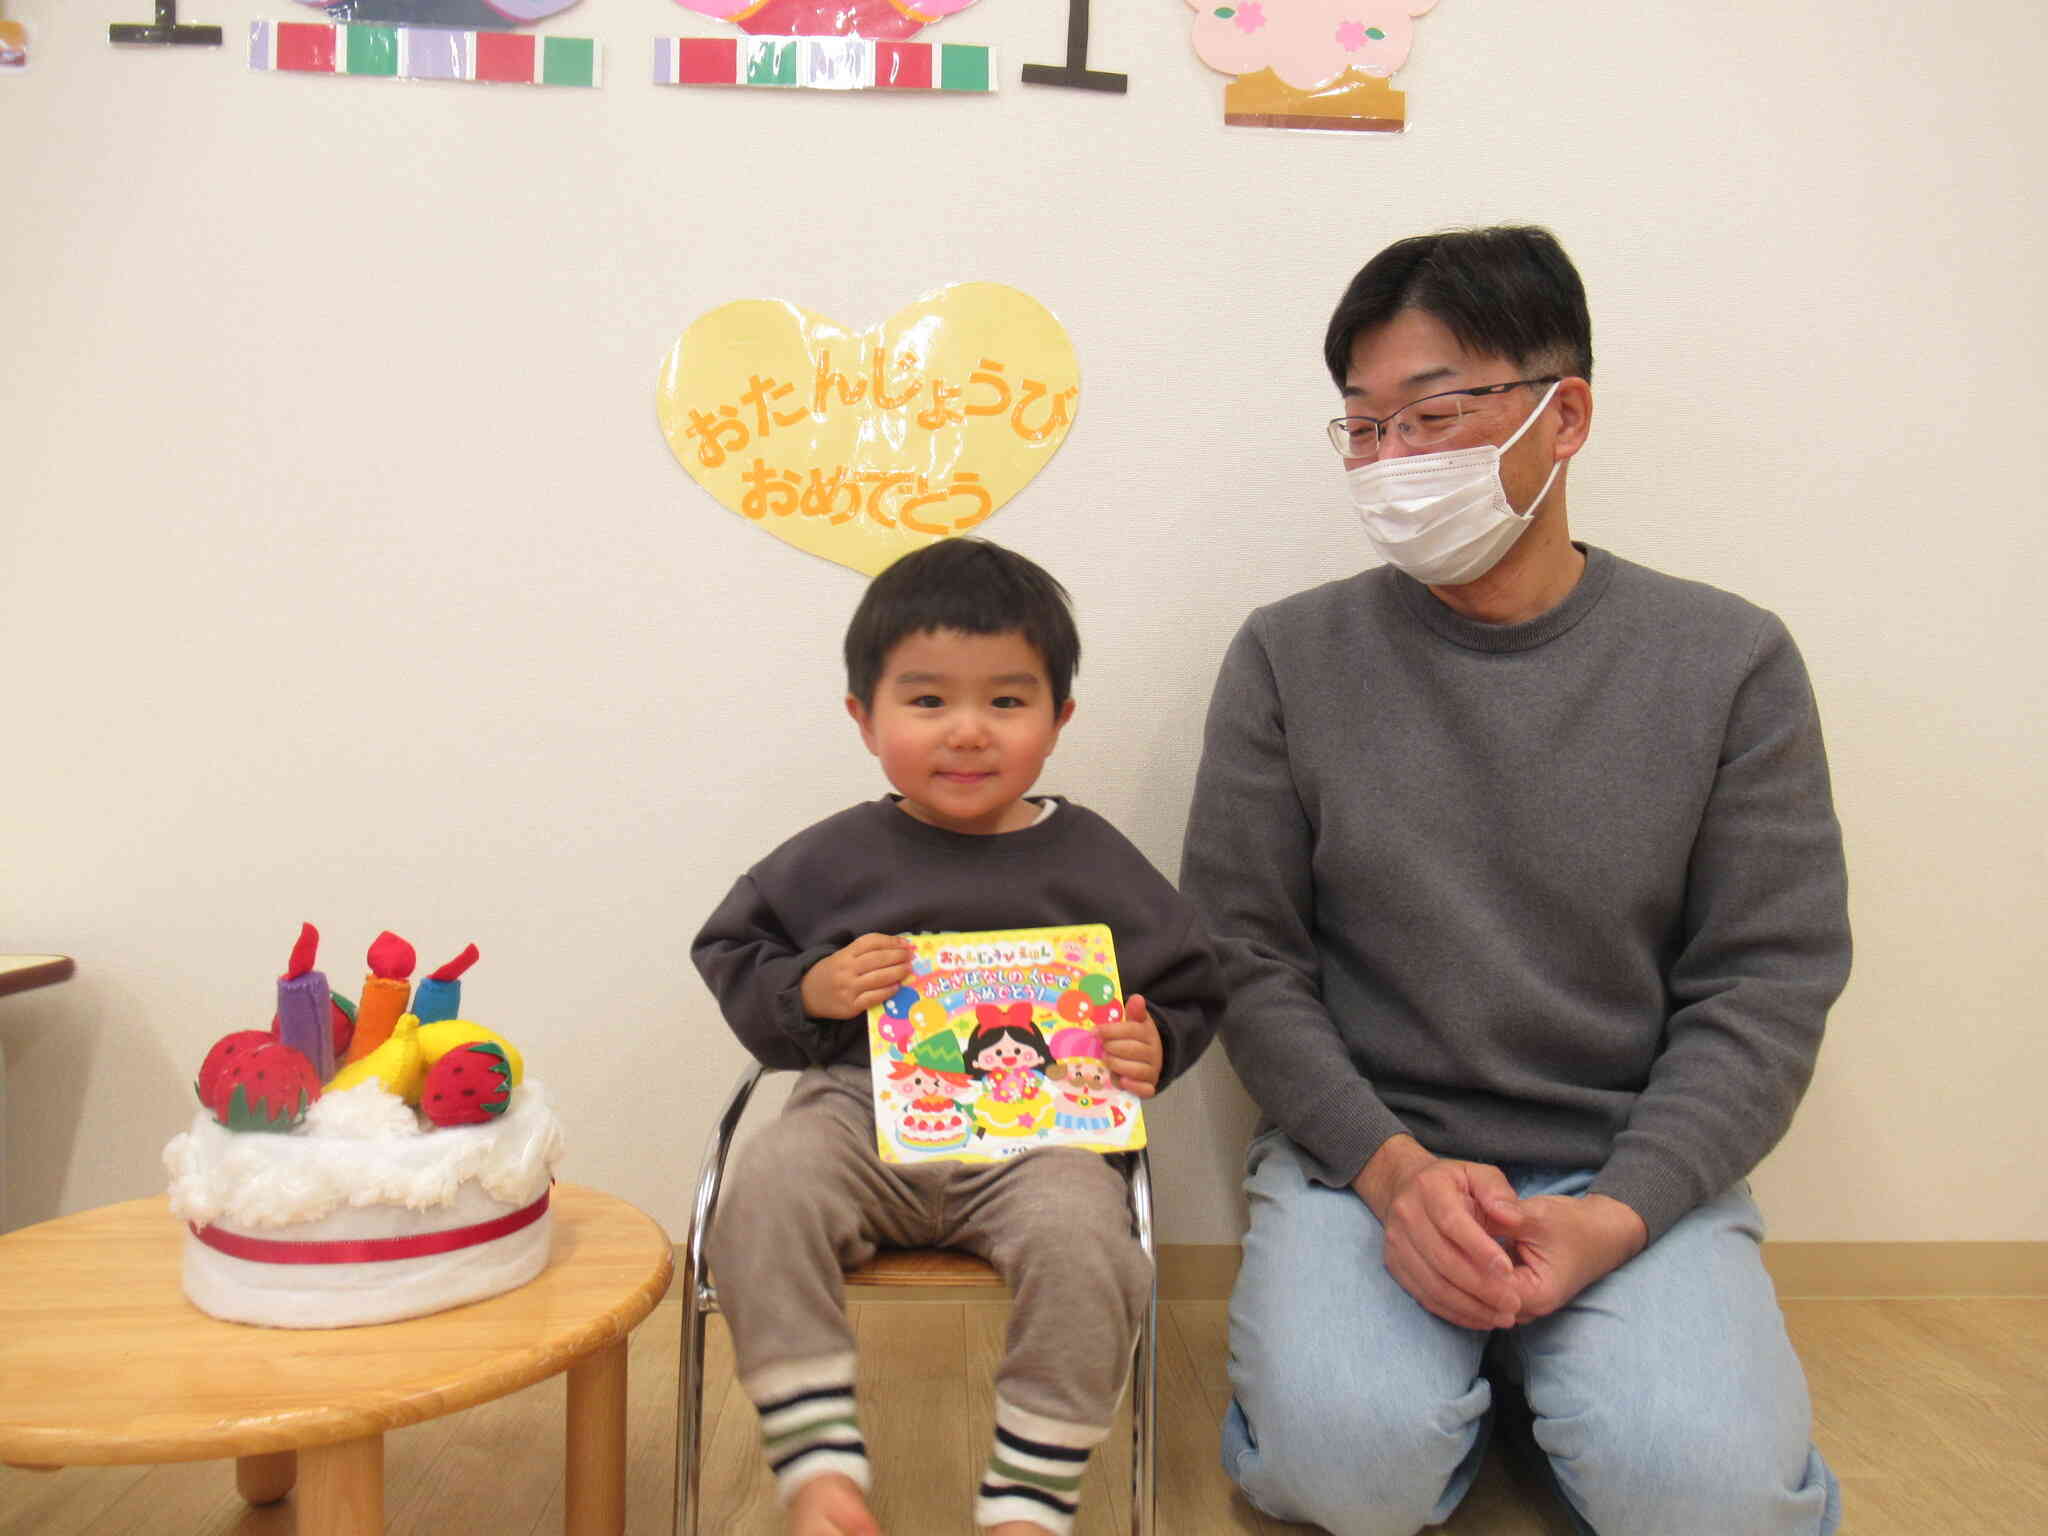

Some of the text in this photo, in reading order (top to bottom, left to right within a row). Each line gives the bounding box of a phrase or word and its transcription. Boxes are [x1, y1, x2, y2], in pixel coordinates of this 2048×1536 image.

[687, 348, 1079, 468] おたんじょうび
[741, 458, 993, 535] おめでとう
